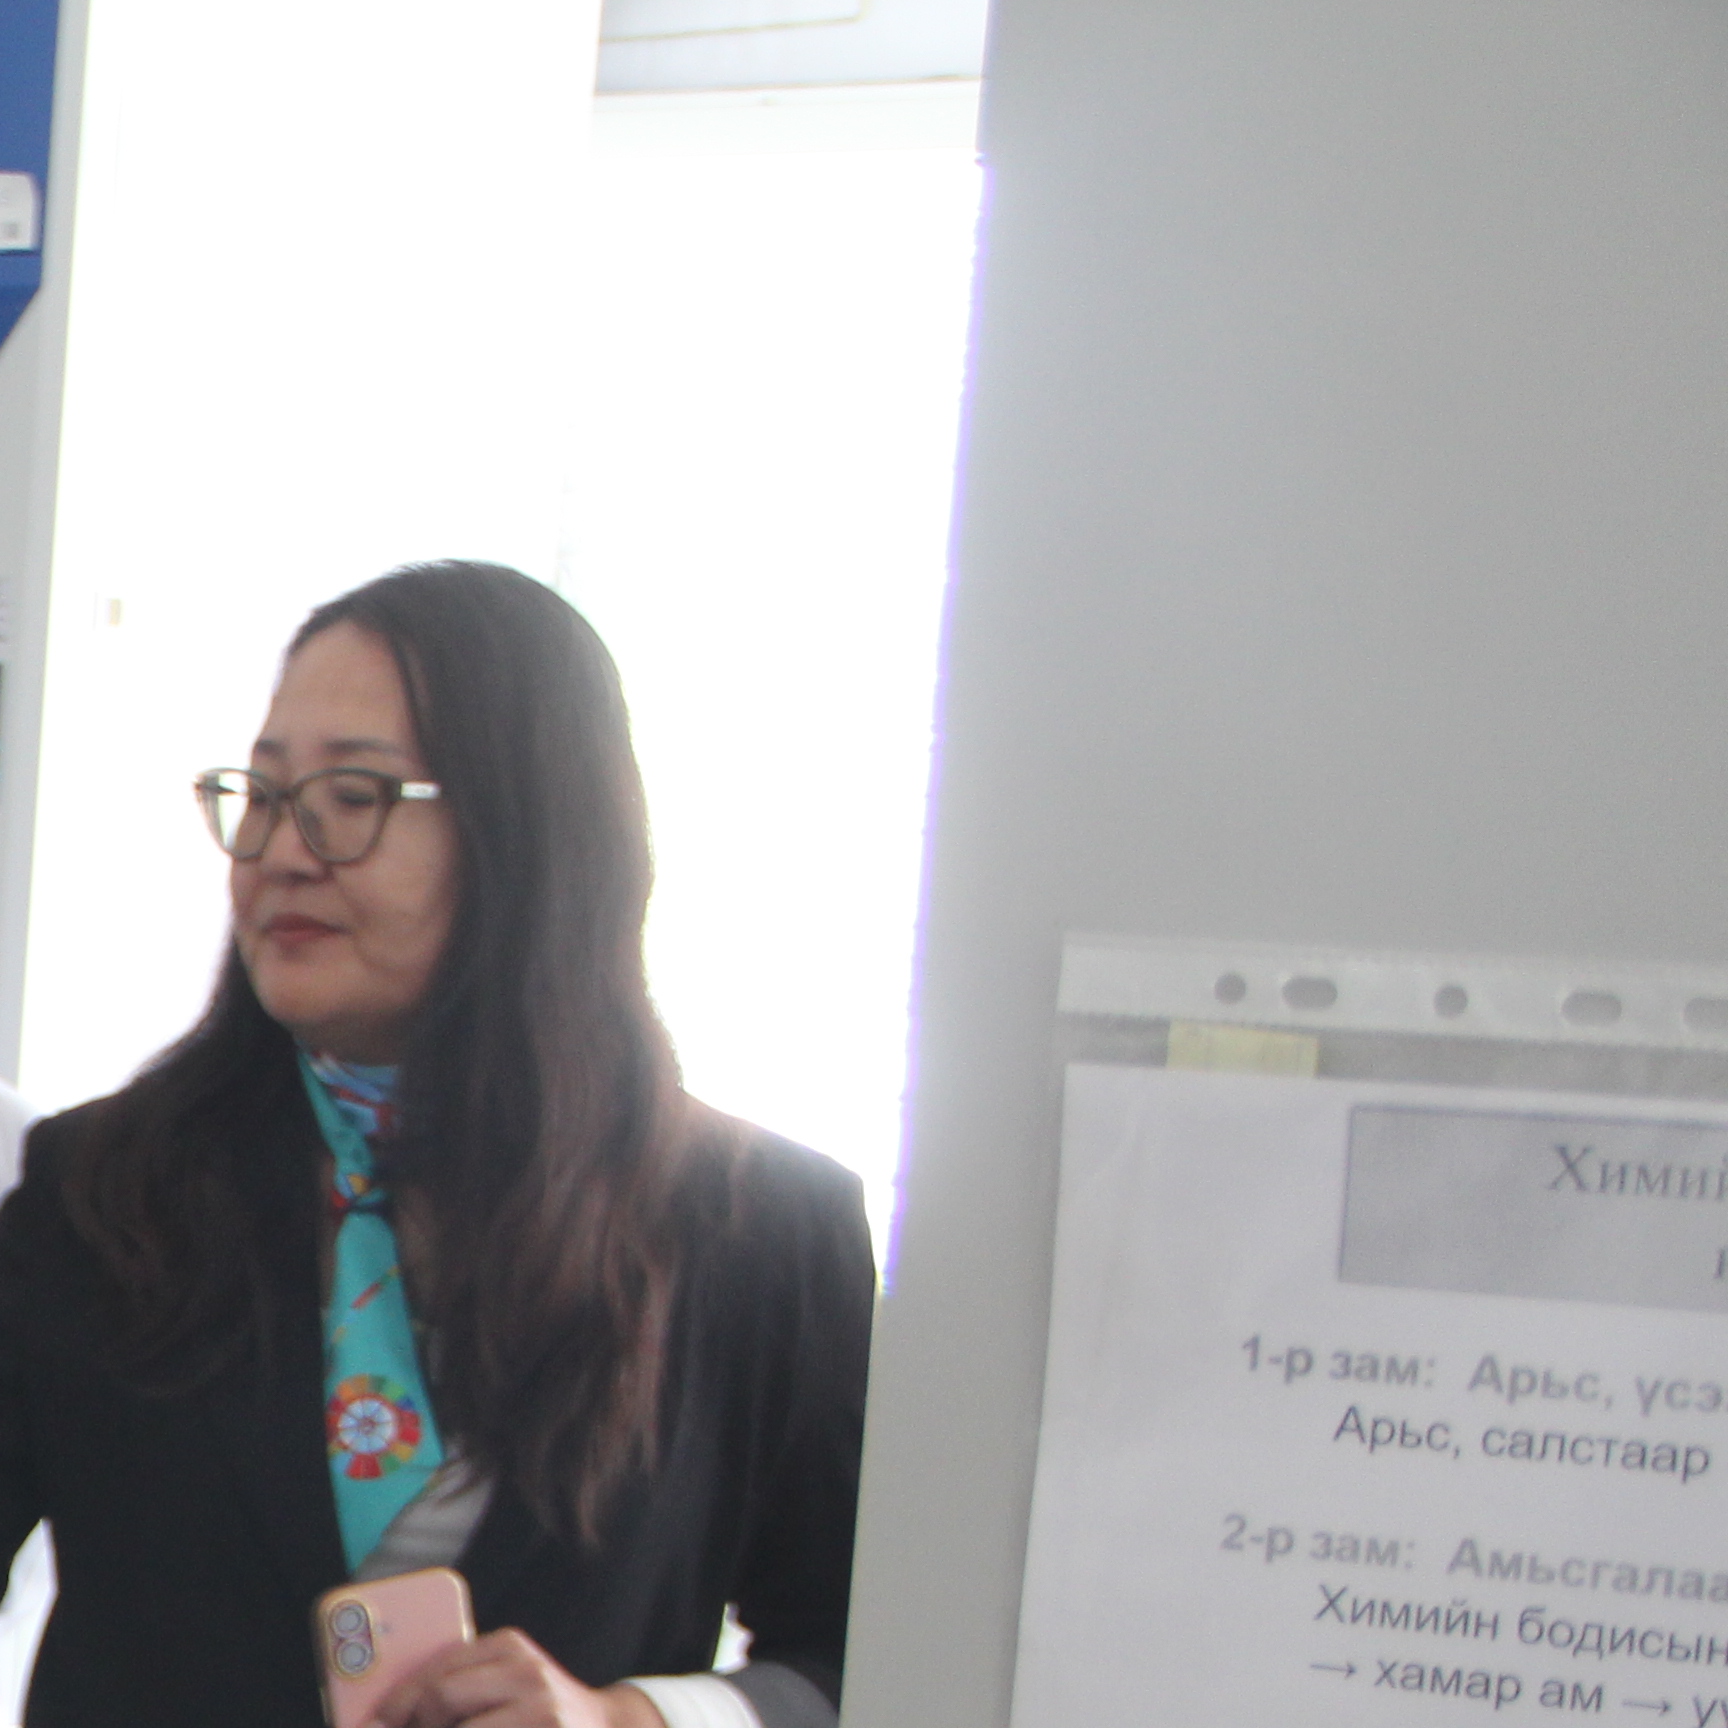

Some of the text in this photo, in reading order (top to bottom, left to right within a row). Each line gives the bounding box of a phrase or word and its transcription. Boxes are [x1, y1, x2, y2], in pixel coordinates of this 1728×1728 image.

[1241, 1335, 1728, 1418] 1-р зам: Арьс, үсэ
[1333, 1404, 1711, 1484] Арьс, салстаар
[1220, 1513, 1296, 1564] 2-р
[1309, 1531, 1417, 1569] зам:
[1313, 1583, 1500, 1642] Химийн
[1374, 1660, 1523, 1711] хамар
[1539, 1679, 1604, 1713] ам
